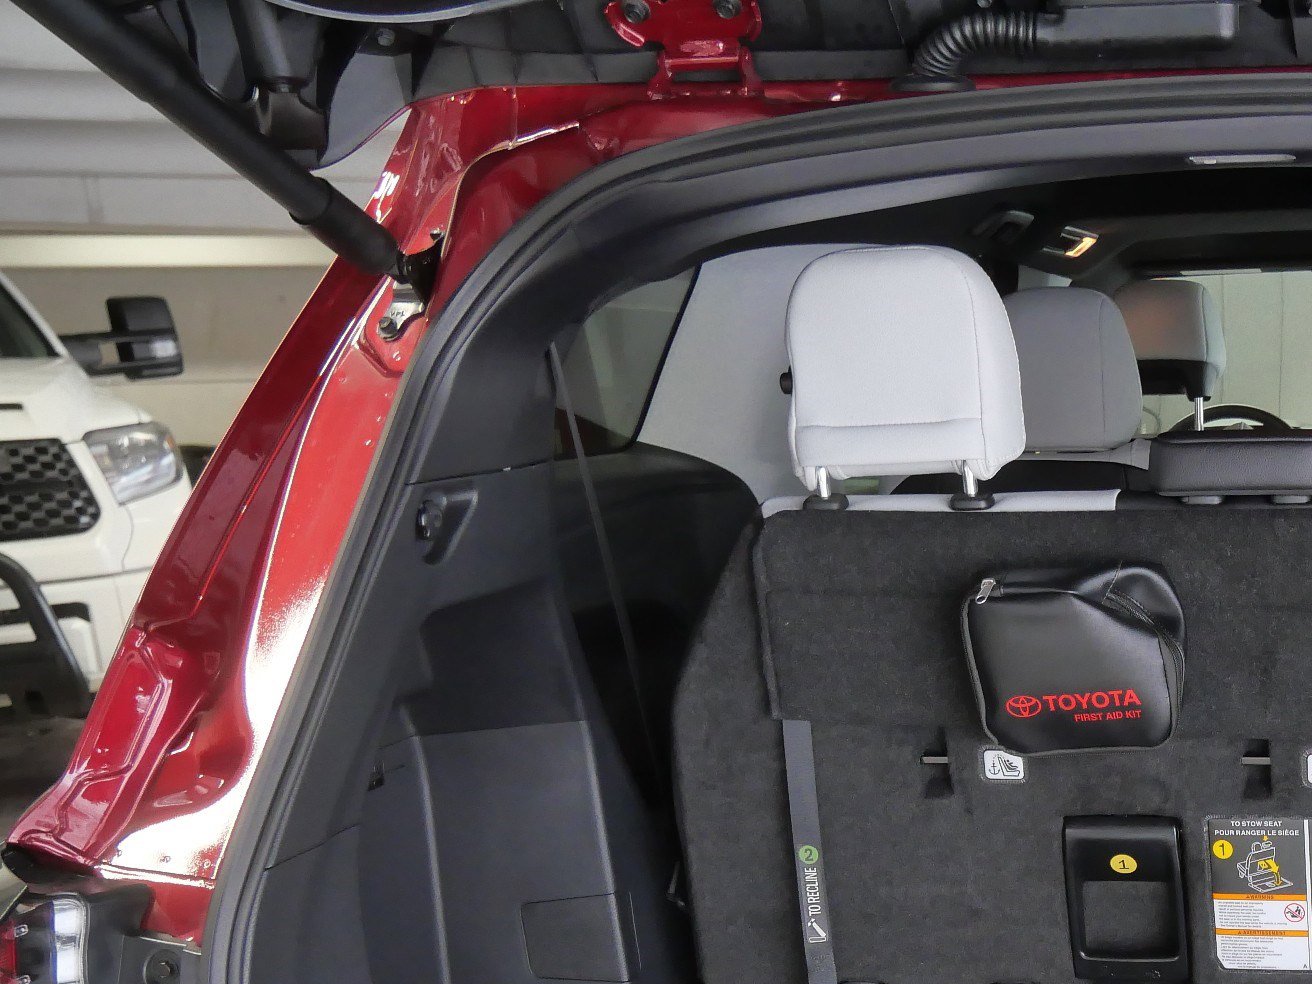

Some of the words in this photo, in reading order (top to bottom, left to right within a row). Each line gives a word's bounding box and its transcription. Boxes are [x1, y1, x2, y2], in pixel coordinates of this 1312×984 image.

[1042, 689, 1142, 712] TOYOTA
[1074, 712, 1103, 722] FIRST
[1106, 710, 1123, 721] AID
[1125, 709, 1142, 719] KIT
[803, 848, 814, 862] 2
[1118, 859, 1130, 870] 1
[804, 867, 821, 904] RECLINE
[807, 904, 822, 917] TO
